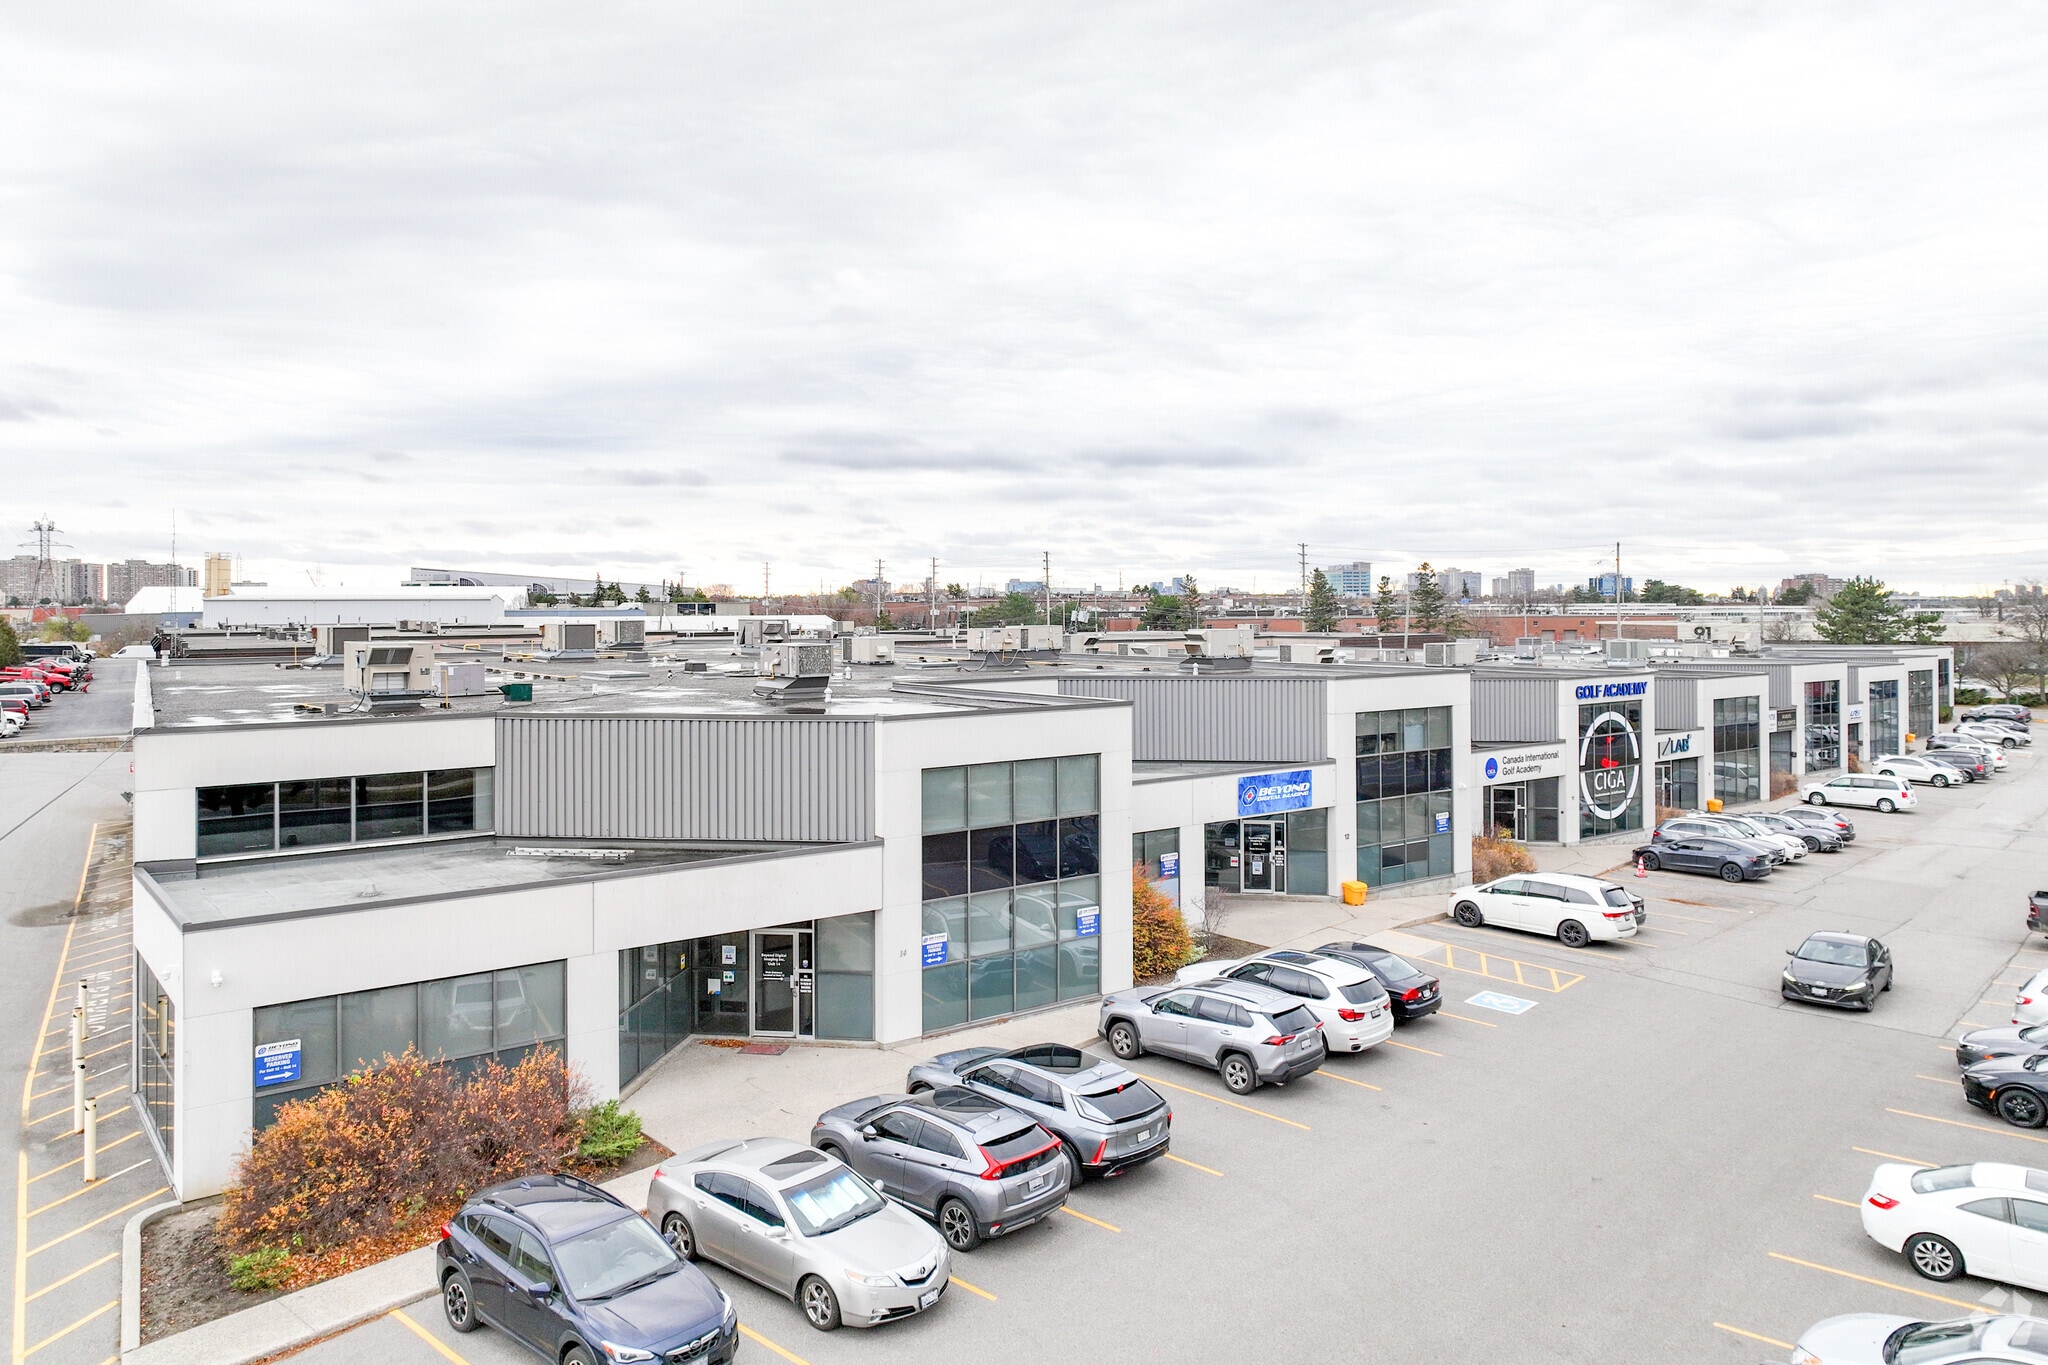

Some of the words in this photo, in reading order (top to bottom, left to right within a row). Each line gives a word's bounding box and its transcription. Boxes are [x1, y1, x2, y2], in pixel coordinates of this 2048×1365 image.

[1694, 626, 1711, 640] 91
[1576, 684, 1602, 699] GOLF
[1603, 682, 1647, 697] ACADEMY
[1502, 755, 1524, 765] Canada
[1525, 750, 1559, 762] International
[1502, 765, 1515, 776] Golf
[1516, 764, 1542, 774] Academy
[1595, 770, 1625, 790] CIGA
[1258, 782, 1310, 795] BEYOND
[1257, 794, 1281, 802] DIGITAL
[1282, 790, 1309, 798] IMAGING
[264, 1053, 293, 1063] RESERVED
[266, 1059, 291, 1068] PARKING
